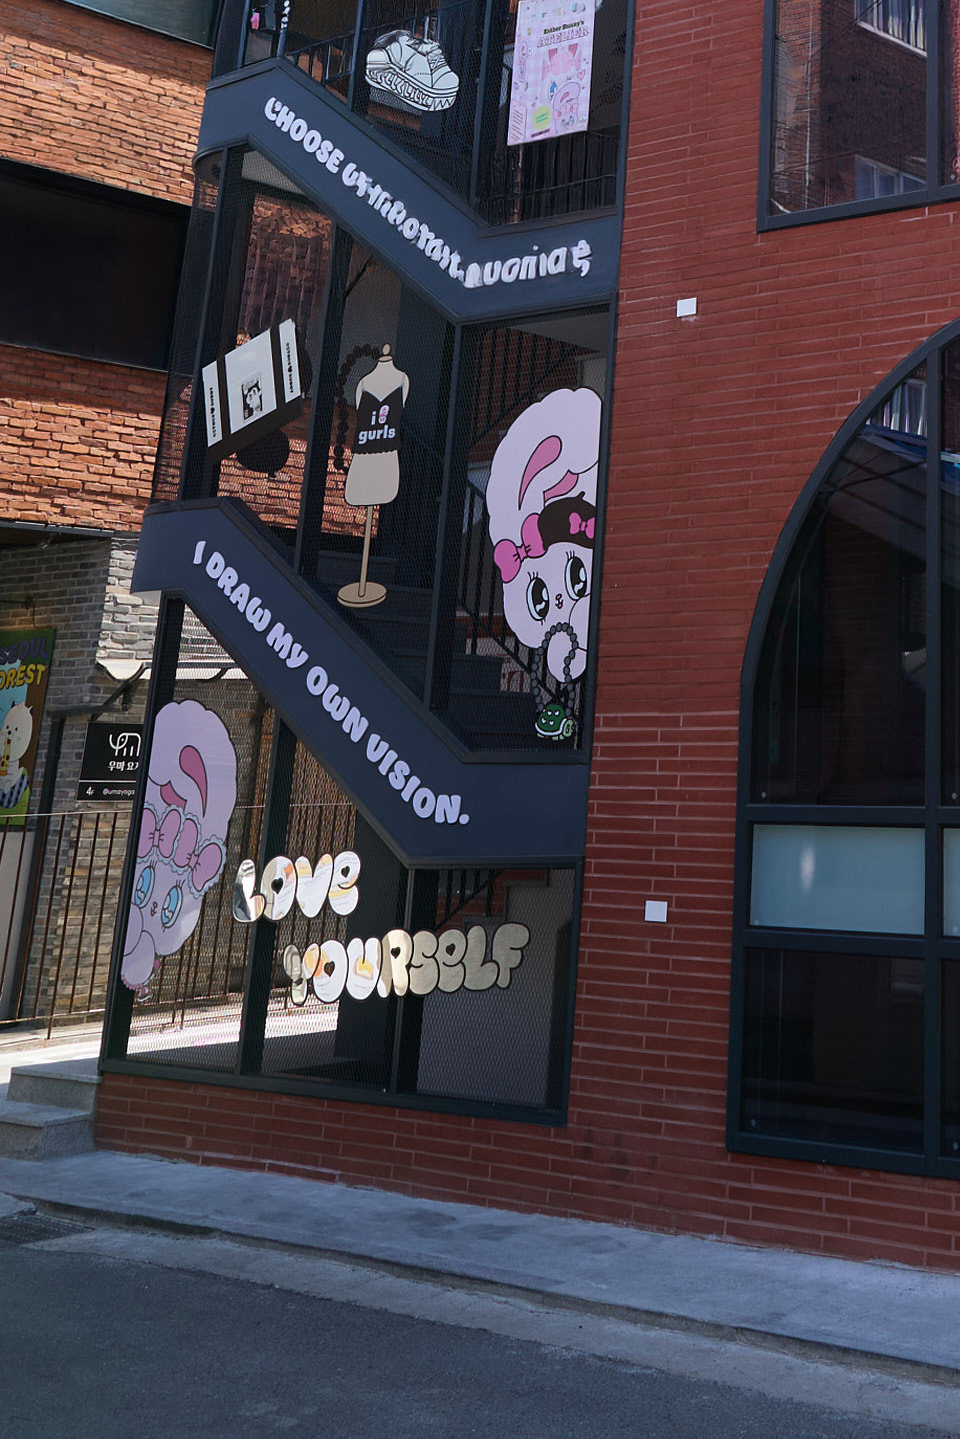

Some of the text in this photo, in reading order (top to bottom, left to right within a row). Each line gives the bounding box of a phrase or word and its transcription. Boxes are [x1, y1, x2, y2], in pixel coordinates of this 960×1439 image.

[264, 97, 344, 174] CHOOSE
[358, 424, 396, 445] gurls
[0, 636, 48, 665] SEOUL
[193, 541, 470, 825] I DRAW MY OWN VISION.
